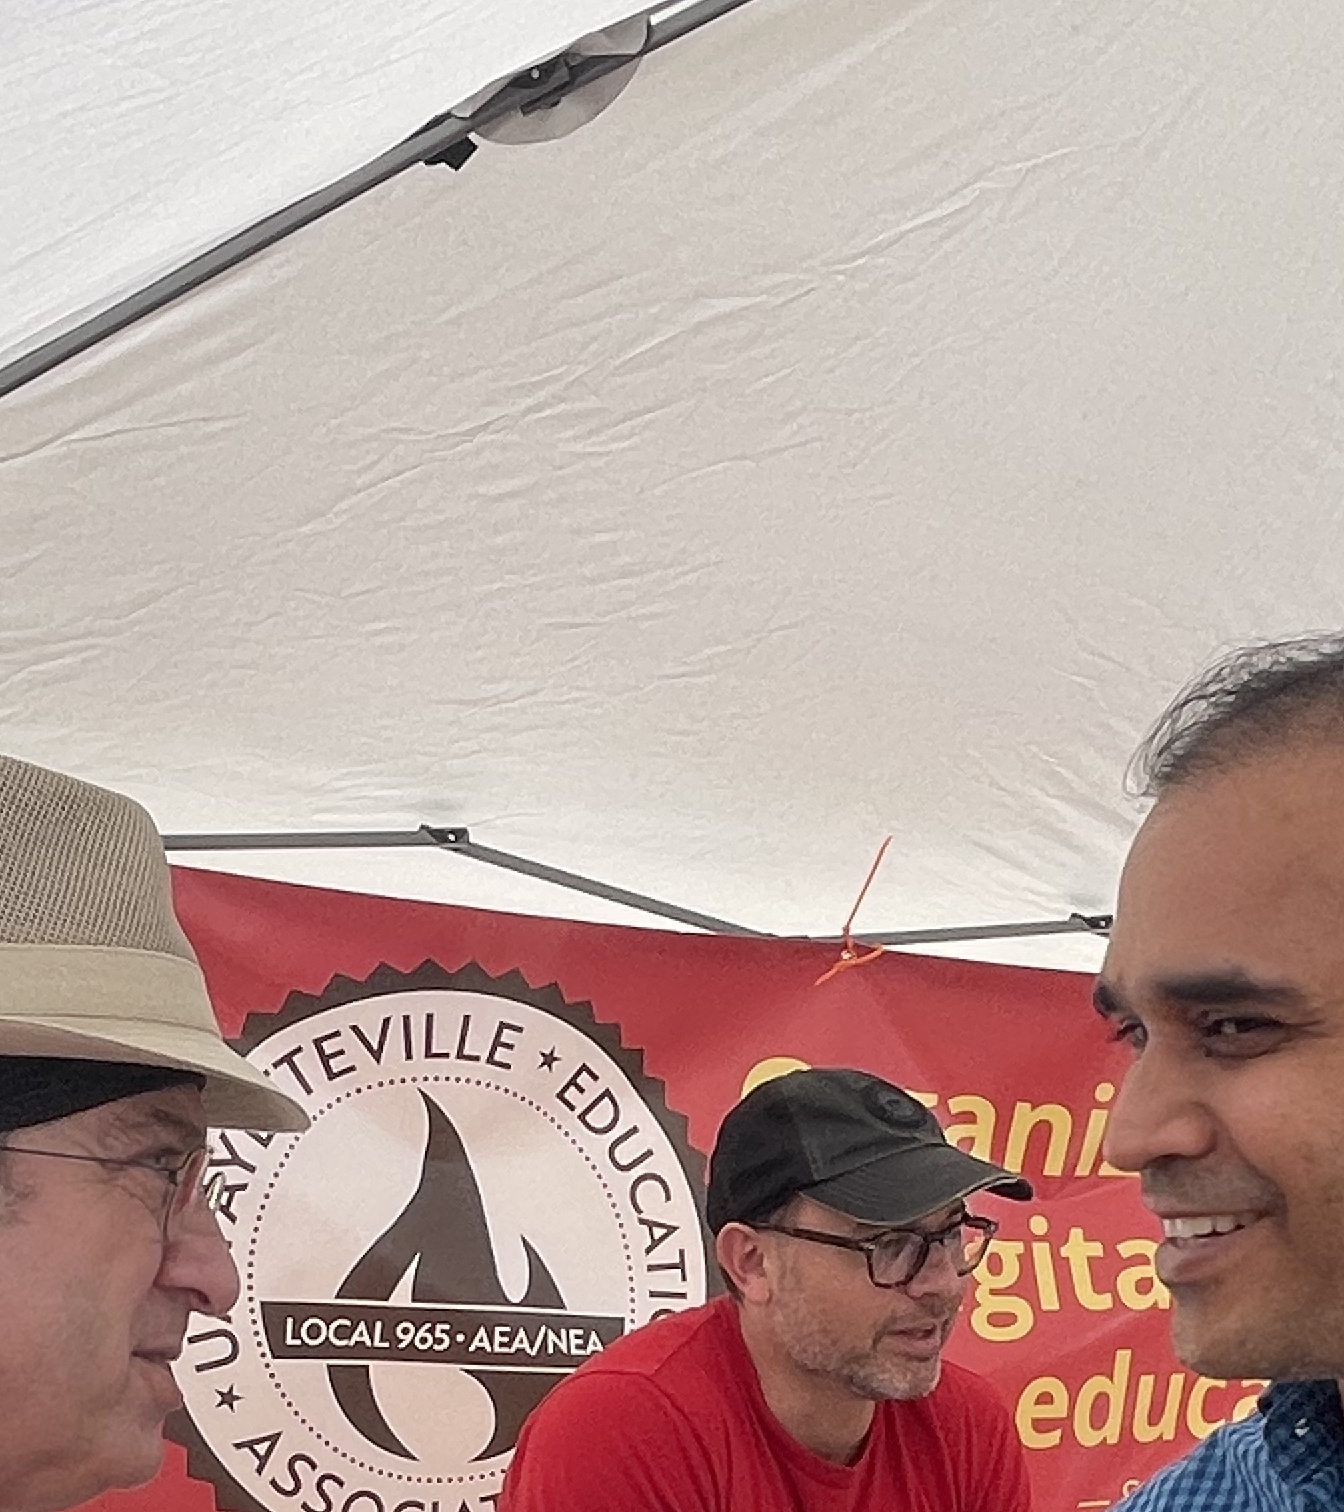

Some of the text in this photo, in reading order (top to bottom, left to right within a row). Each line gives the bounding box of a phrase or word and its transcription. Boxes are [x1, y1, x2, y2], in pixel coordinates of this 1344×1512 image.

[556, 1062, 687, 1322] EDUCATI
[284, 1316, 604, 1356] LOCAL 965 AEA/NEA
